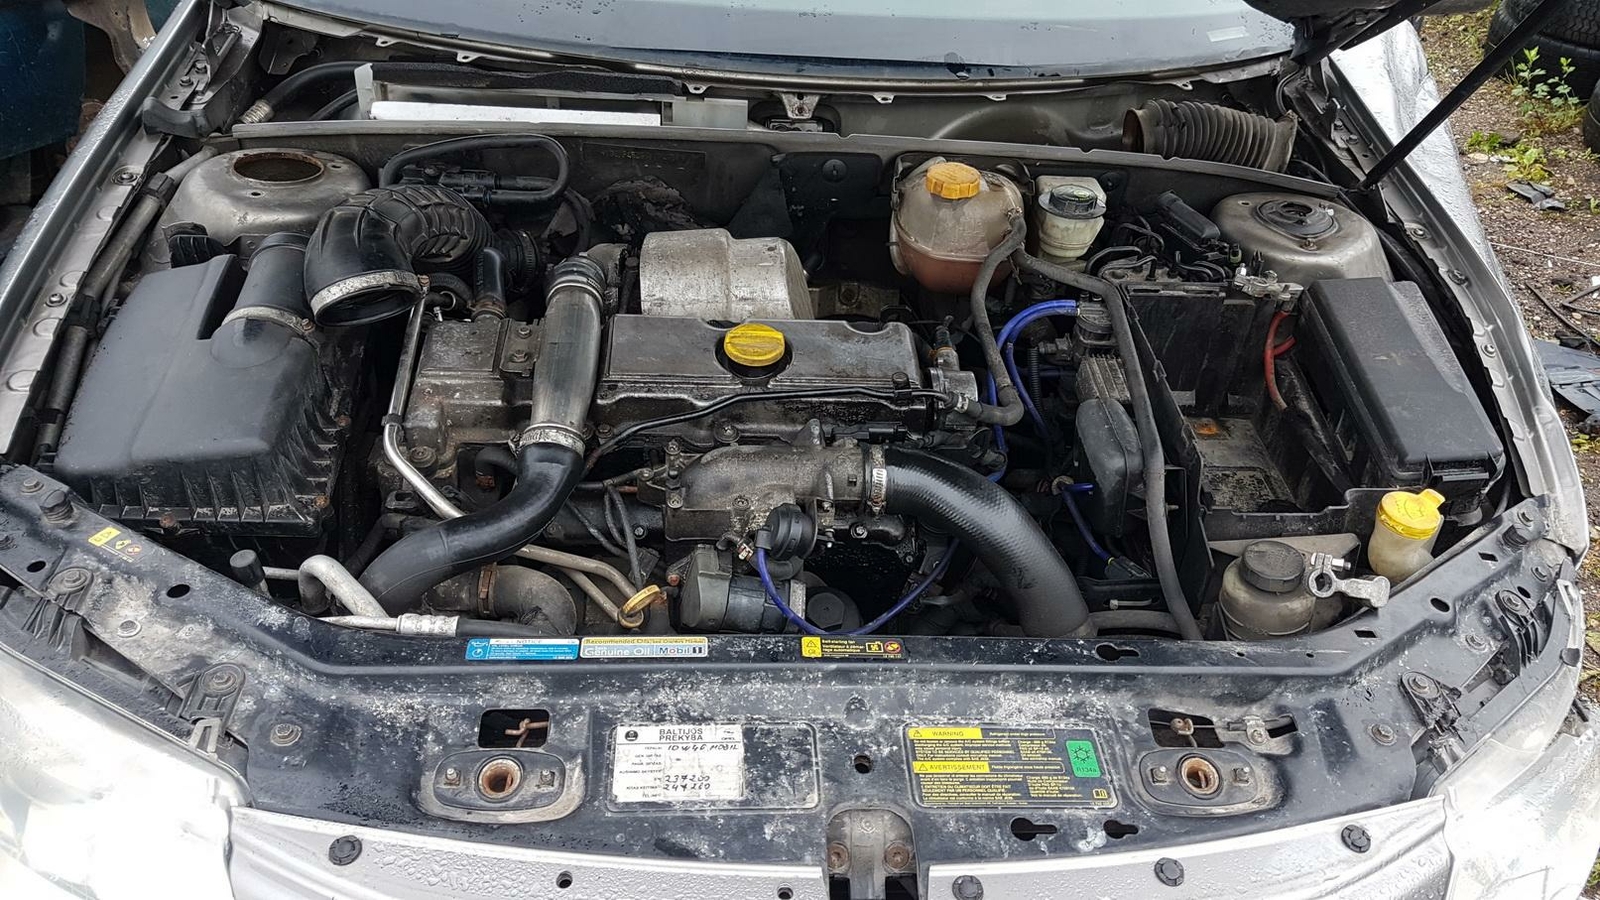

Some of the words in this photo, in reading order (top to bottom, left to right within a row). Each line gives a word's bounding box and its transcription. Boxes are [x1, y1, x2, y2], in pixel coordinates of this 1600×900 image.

[584, 648, 630, 656] Genuine
[633, 646, 650, 656] Oil
[659, 646, 690, 654] Mobil
